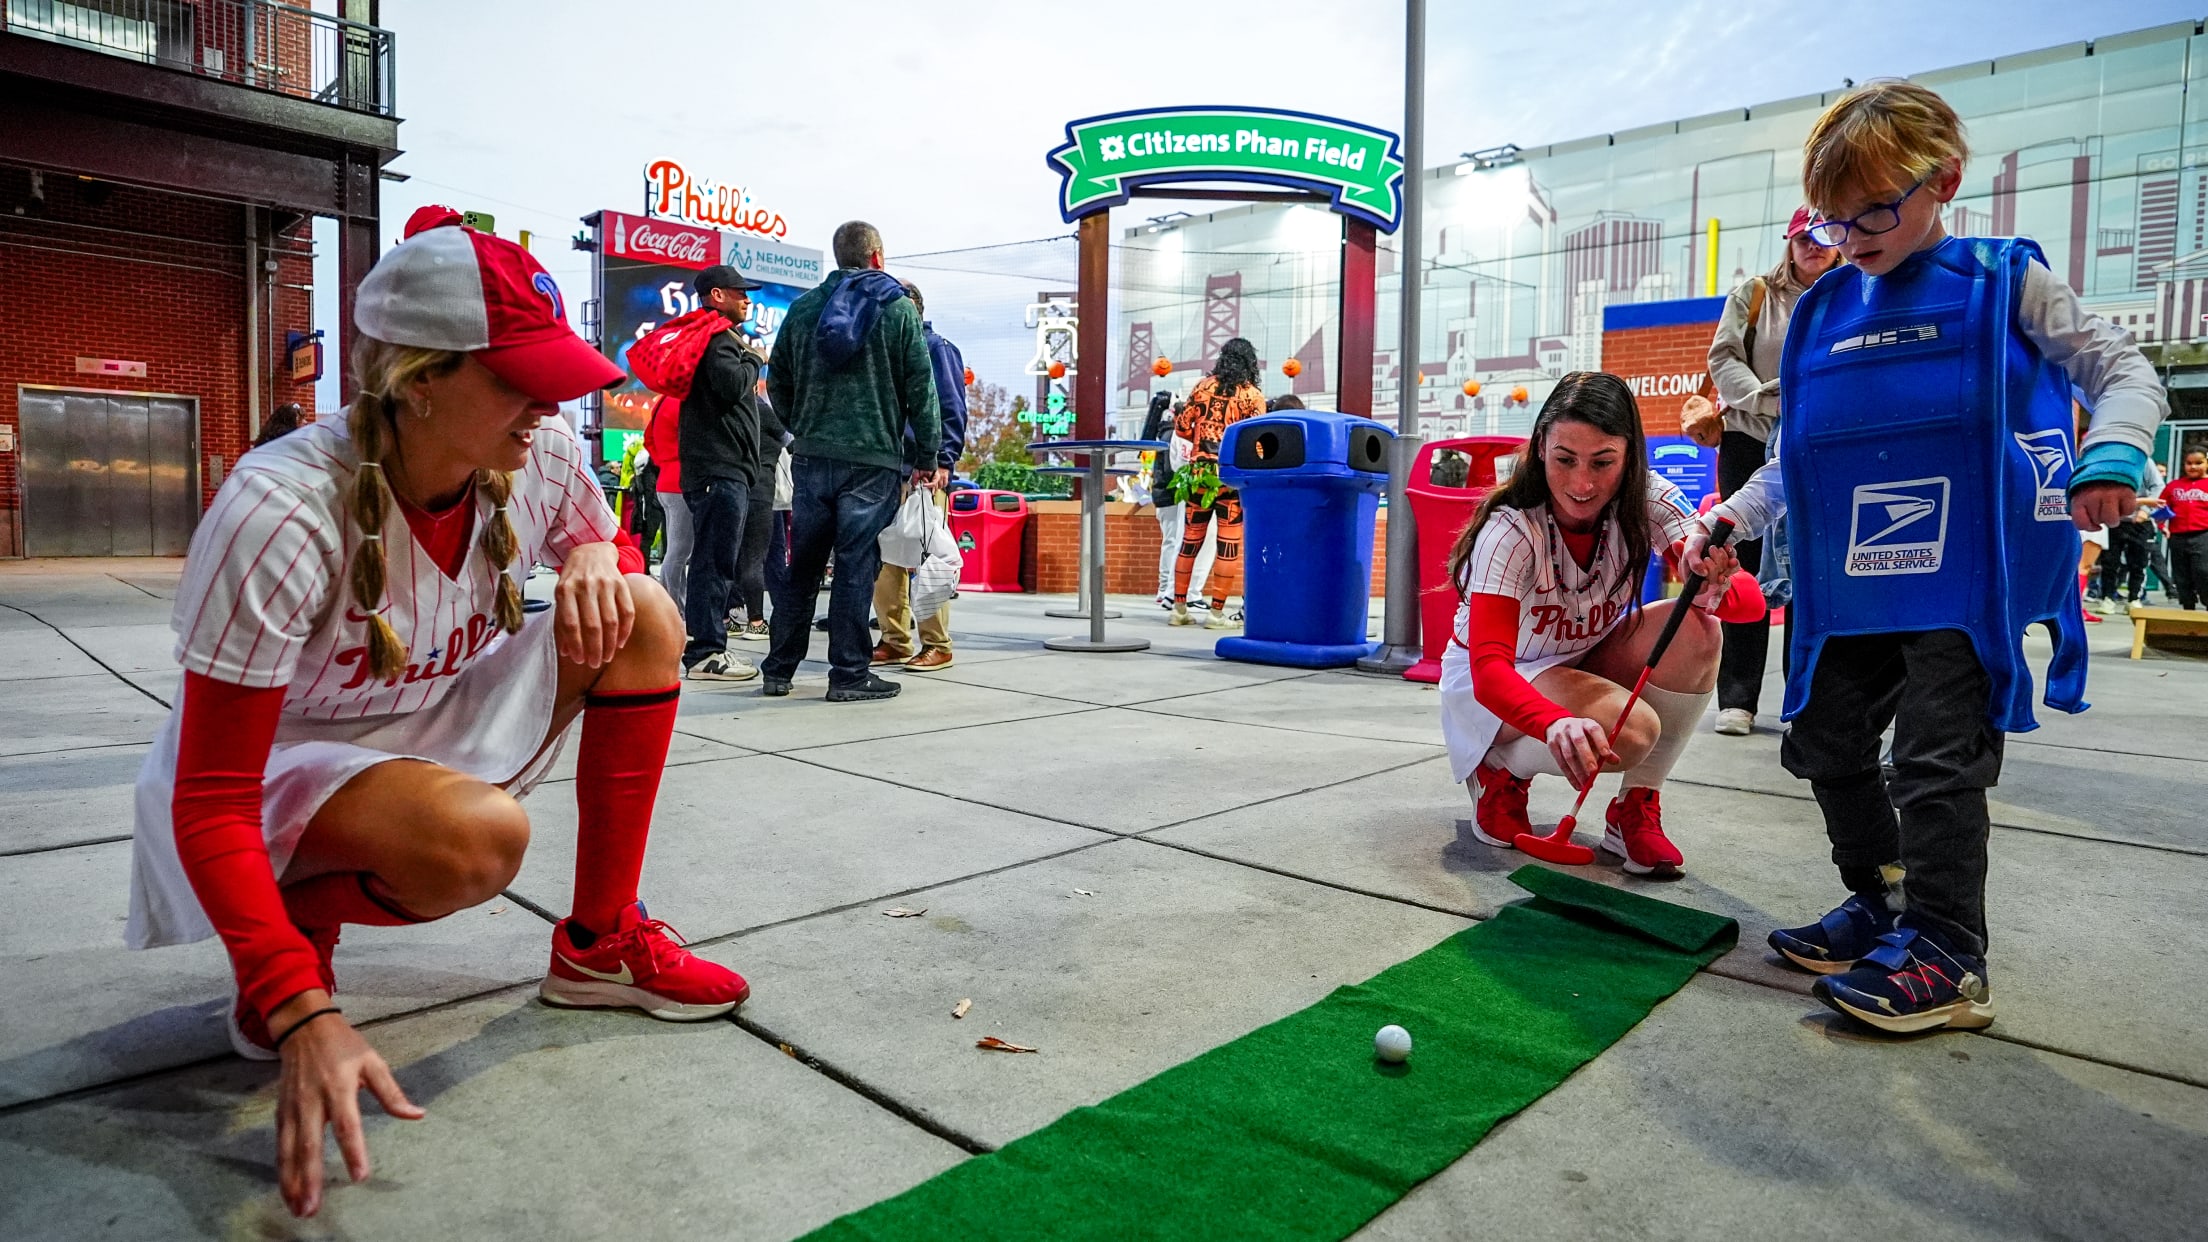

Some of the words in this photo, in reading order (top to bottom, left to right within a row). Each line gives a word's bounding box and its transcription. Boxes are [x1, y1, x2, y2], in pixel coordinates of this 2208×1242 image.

[1127, 130, 1230, 157] Citizens
[1235, 129, 1299, 158] Phan
[1304, 137, 1367, 172] Field
[649, 160, 787, 237] Phillies
[630, 224, 711, 262] Coca-Cola
[756, 250, 819, 272] NEMOURS
[756, 264, 794, 279] CHILDREN'S
[794, 271, 819, 282] HEALTH
[1017, 410, 1063, 423] Citizens
[1042, 422, 1069, 434] Park
[2040, 495, 2063, 504] UNITED
[2037, 506, 2066, 516] POSTAL
[1852, 551, 1893, 561] UNITED
[1894, 548, 1933, 559] STATES
[1850, 561, 1890, 571] POSTAL
